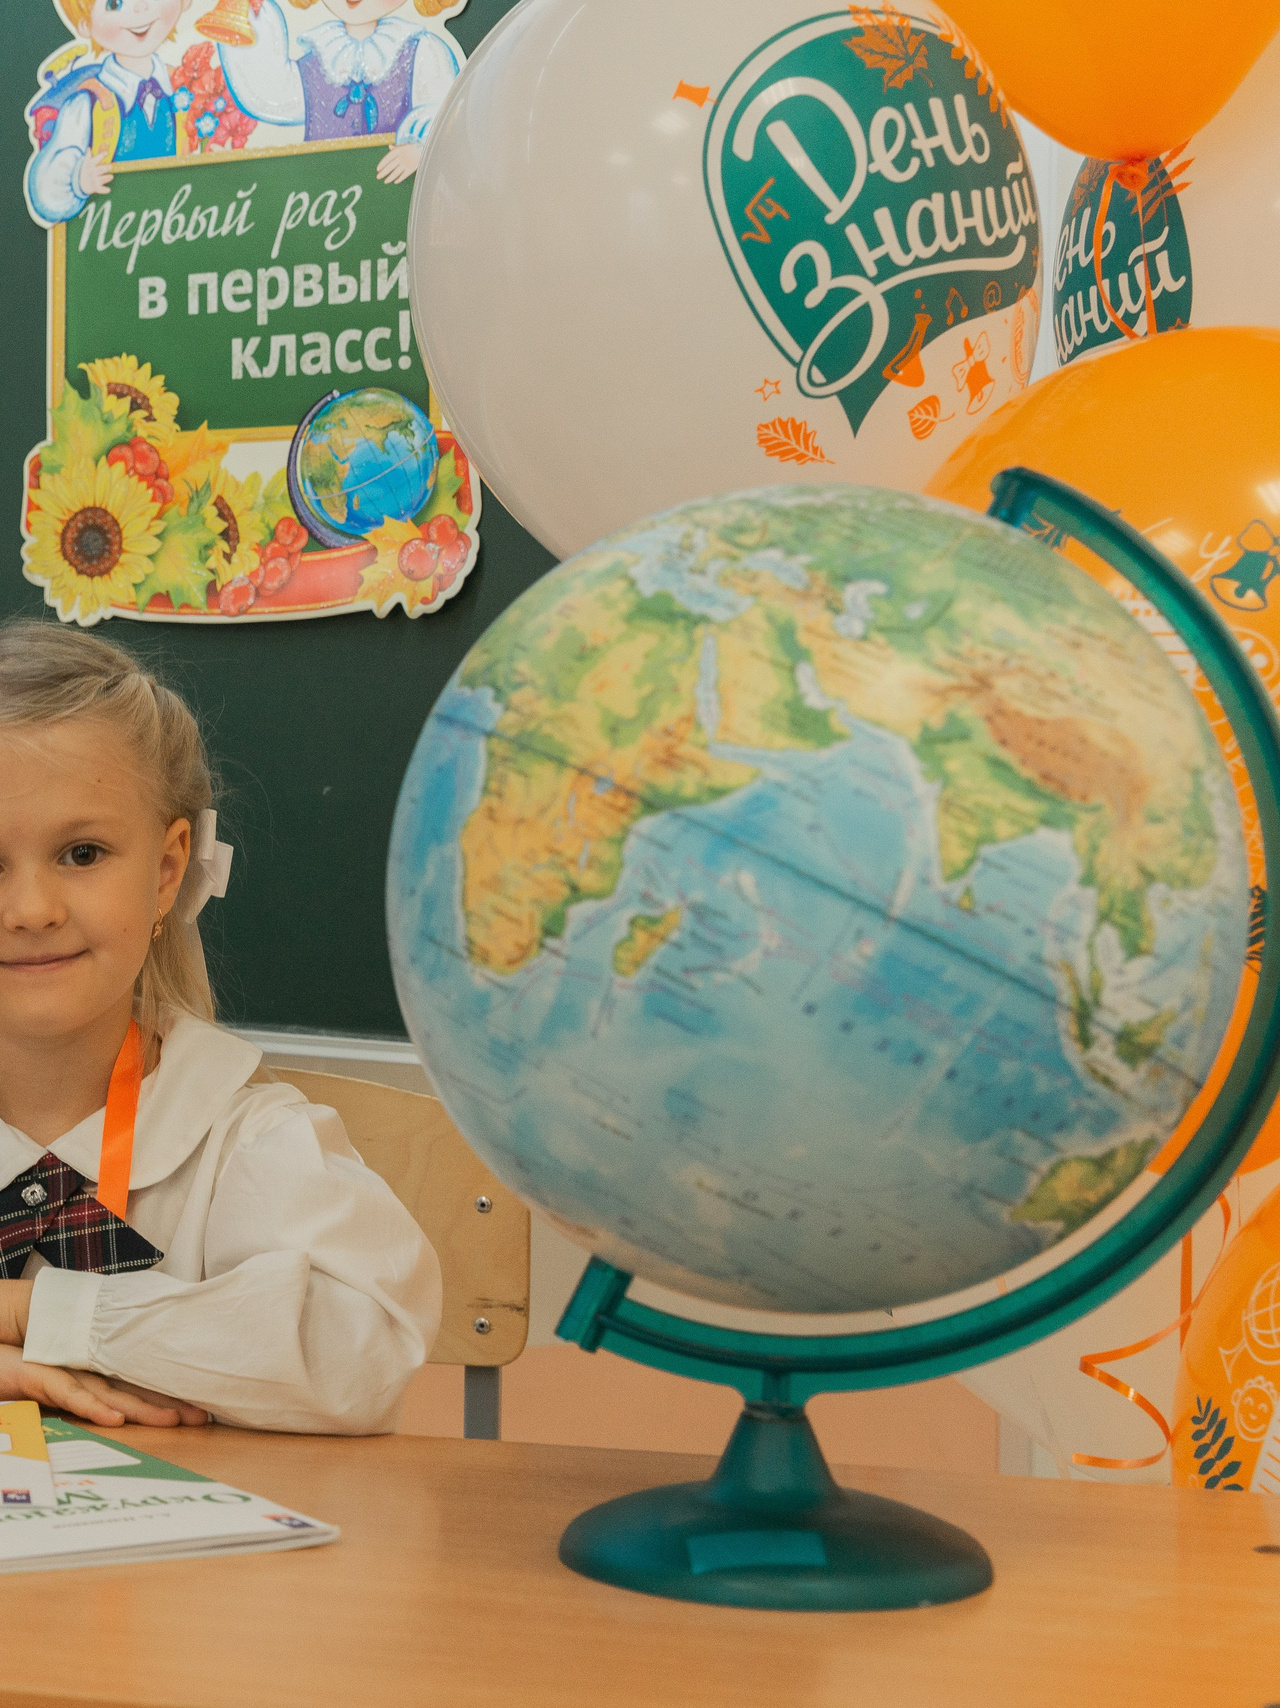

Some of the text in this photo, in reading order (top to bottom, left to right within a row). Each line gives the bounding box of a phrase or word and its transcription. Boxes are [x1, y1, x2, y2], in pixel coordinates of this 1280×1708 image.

[732, 76, 990, 224] День
[77, 183, 363, 275] Первый раз
[138, 240, 410, 326] в первый
[780, 155, 1037, 398] Знаний
[231, 309, 413, 380] класс!
